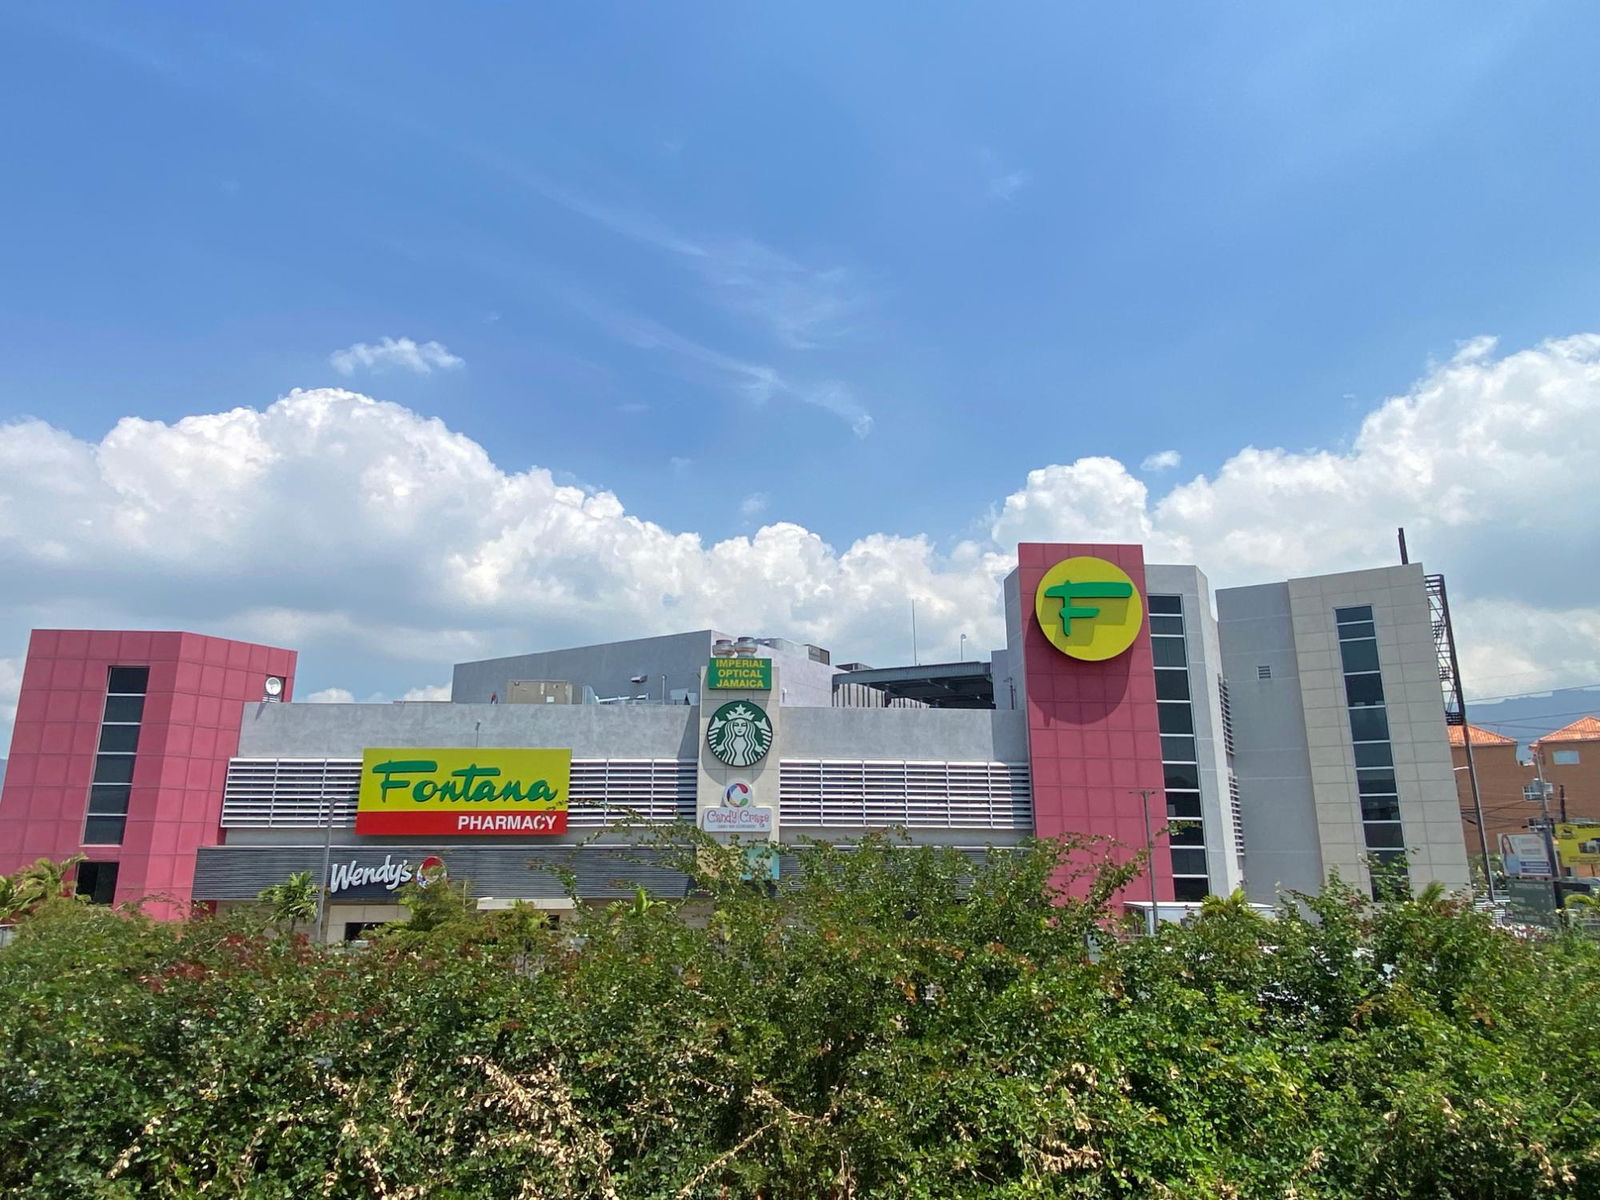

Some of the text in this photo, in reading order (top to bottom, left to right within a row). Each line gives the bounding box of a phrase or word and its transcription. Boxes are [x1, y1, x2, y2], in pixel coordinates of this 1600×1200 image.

[1044, 579, 1133, 636] F
[716, 659, 765, 668] IMPERIAL
[718, 669, 763, 678] OPTICAL
[716, 679, 764, 688] JAMAICA
[372, 760, 559, 803] Fontana
[458, 815, 557, 830] PHARMACY
[707, 810, 738, 824] Candy
[330, 855, 413, 893] Wendy's
